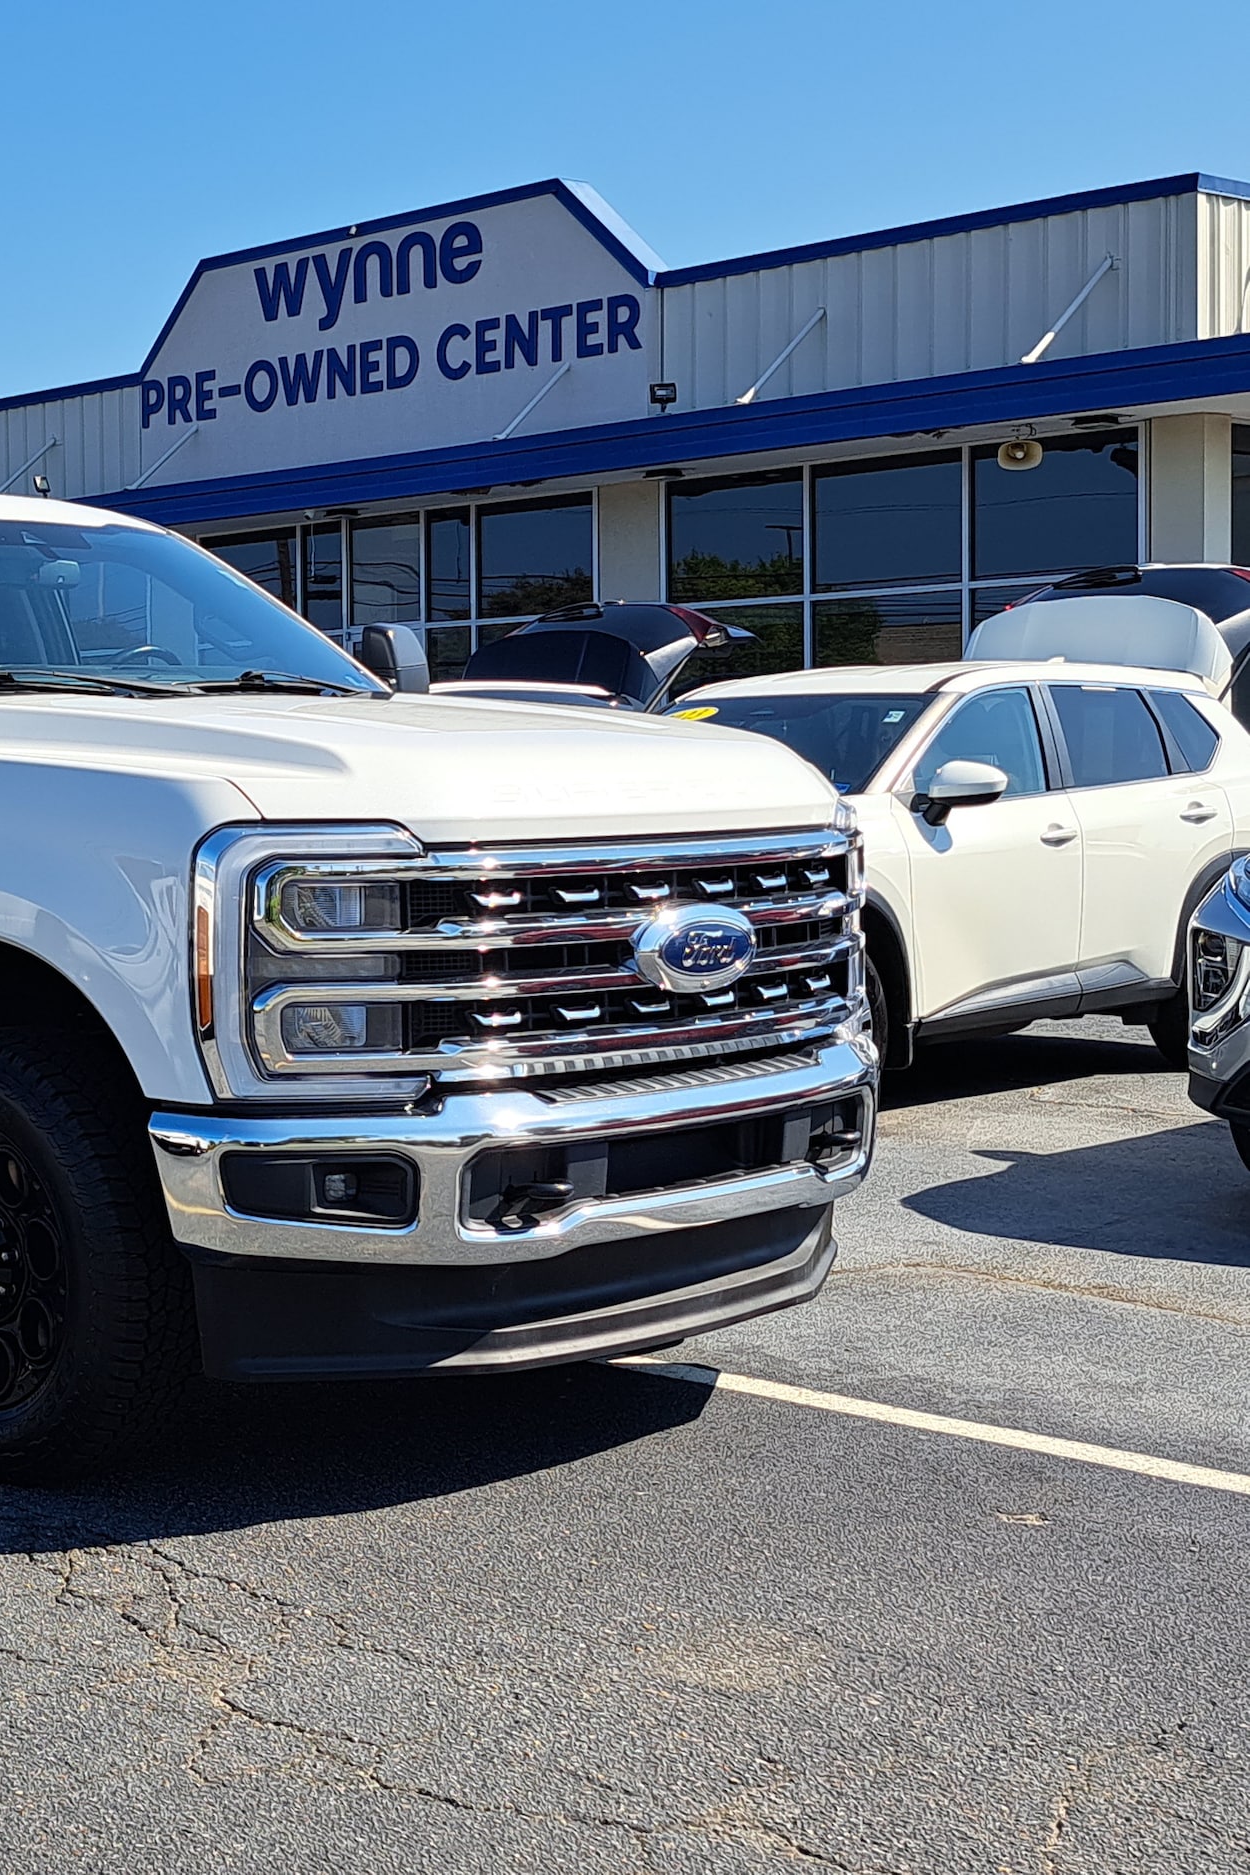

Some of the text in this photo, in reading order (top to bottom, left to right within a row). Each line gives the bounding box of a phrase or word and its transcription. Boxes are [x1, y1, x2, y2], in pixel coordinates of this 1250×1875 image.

[254, 221, 483, 331] wynne
[141, 293, 642, 428] PRE-OWNED CENTER
[682, 930, 737, 967] Ford
